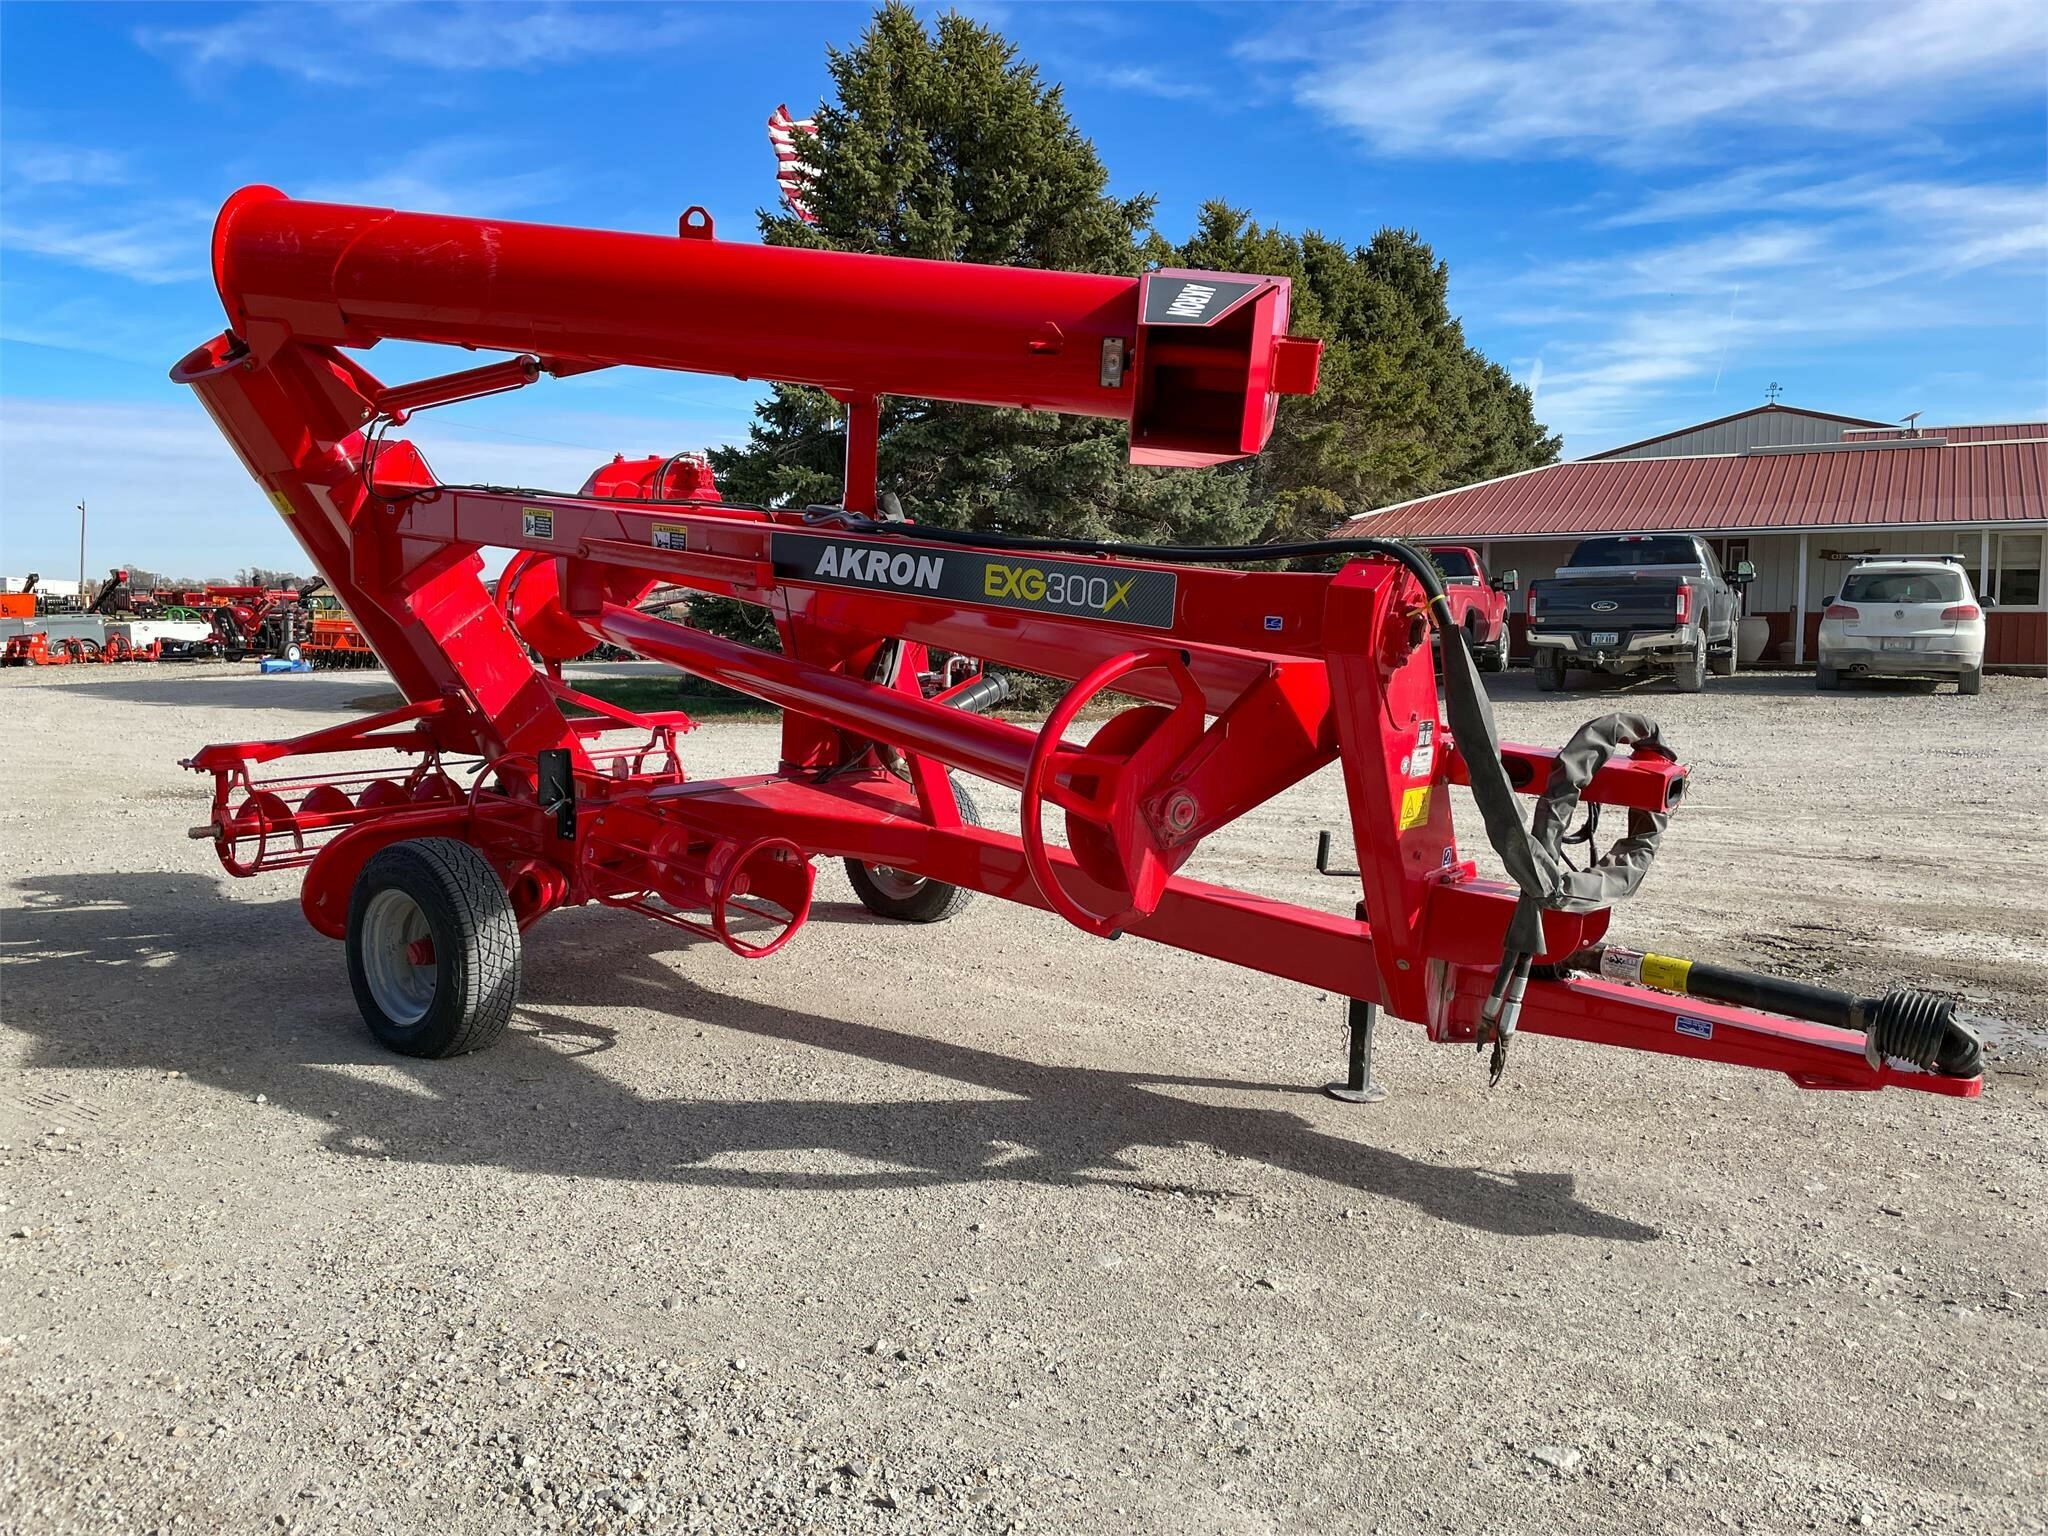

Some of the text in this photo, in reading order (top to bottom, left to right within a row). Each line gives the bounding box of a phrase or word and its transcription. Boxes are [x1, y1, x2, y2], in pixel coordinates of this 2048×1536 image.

[1166, 283, 1217, 318] AKRON
[815, 546, 944, 590] AKRON
[984, 563, 1138, 613] EXG300X
